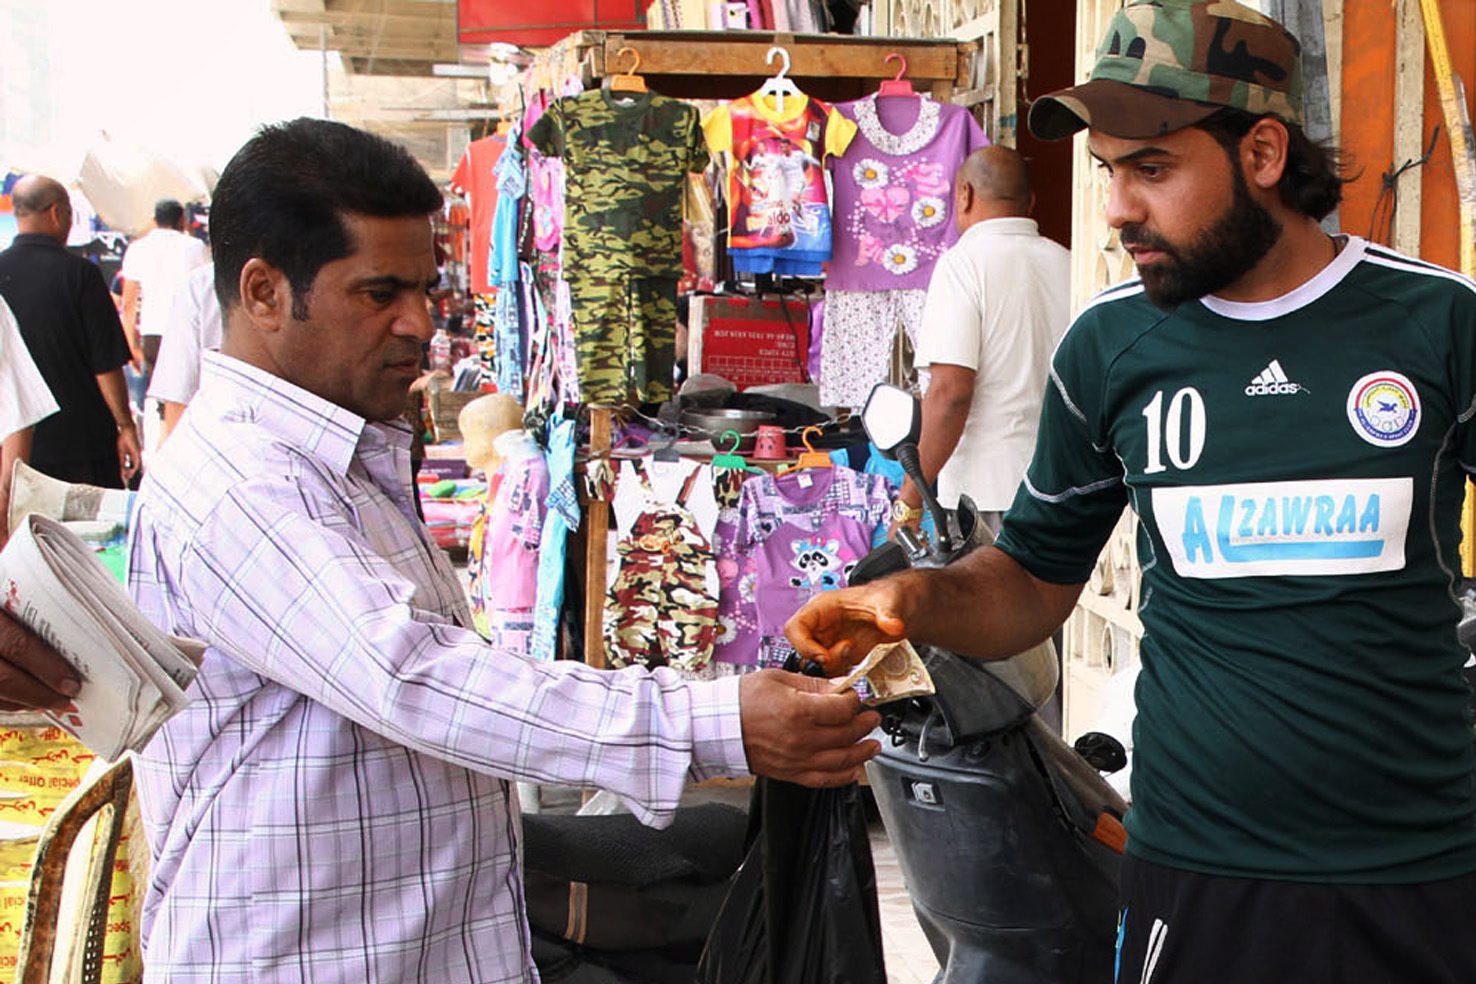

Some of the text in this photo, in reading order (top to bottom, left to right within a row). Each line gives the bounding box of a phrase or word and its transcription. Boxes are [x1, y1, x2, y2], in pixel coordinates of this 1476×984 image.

[1244, 382, 1300, 396] adidas
[1142, 386, 1207, 474] 10
[48, 776, 80, 790] pecial
